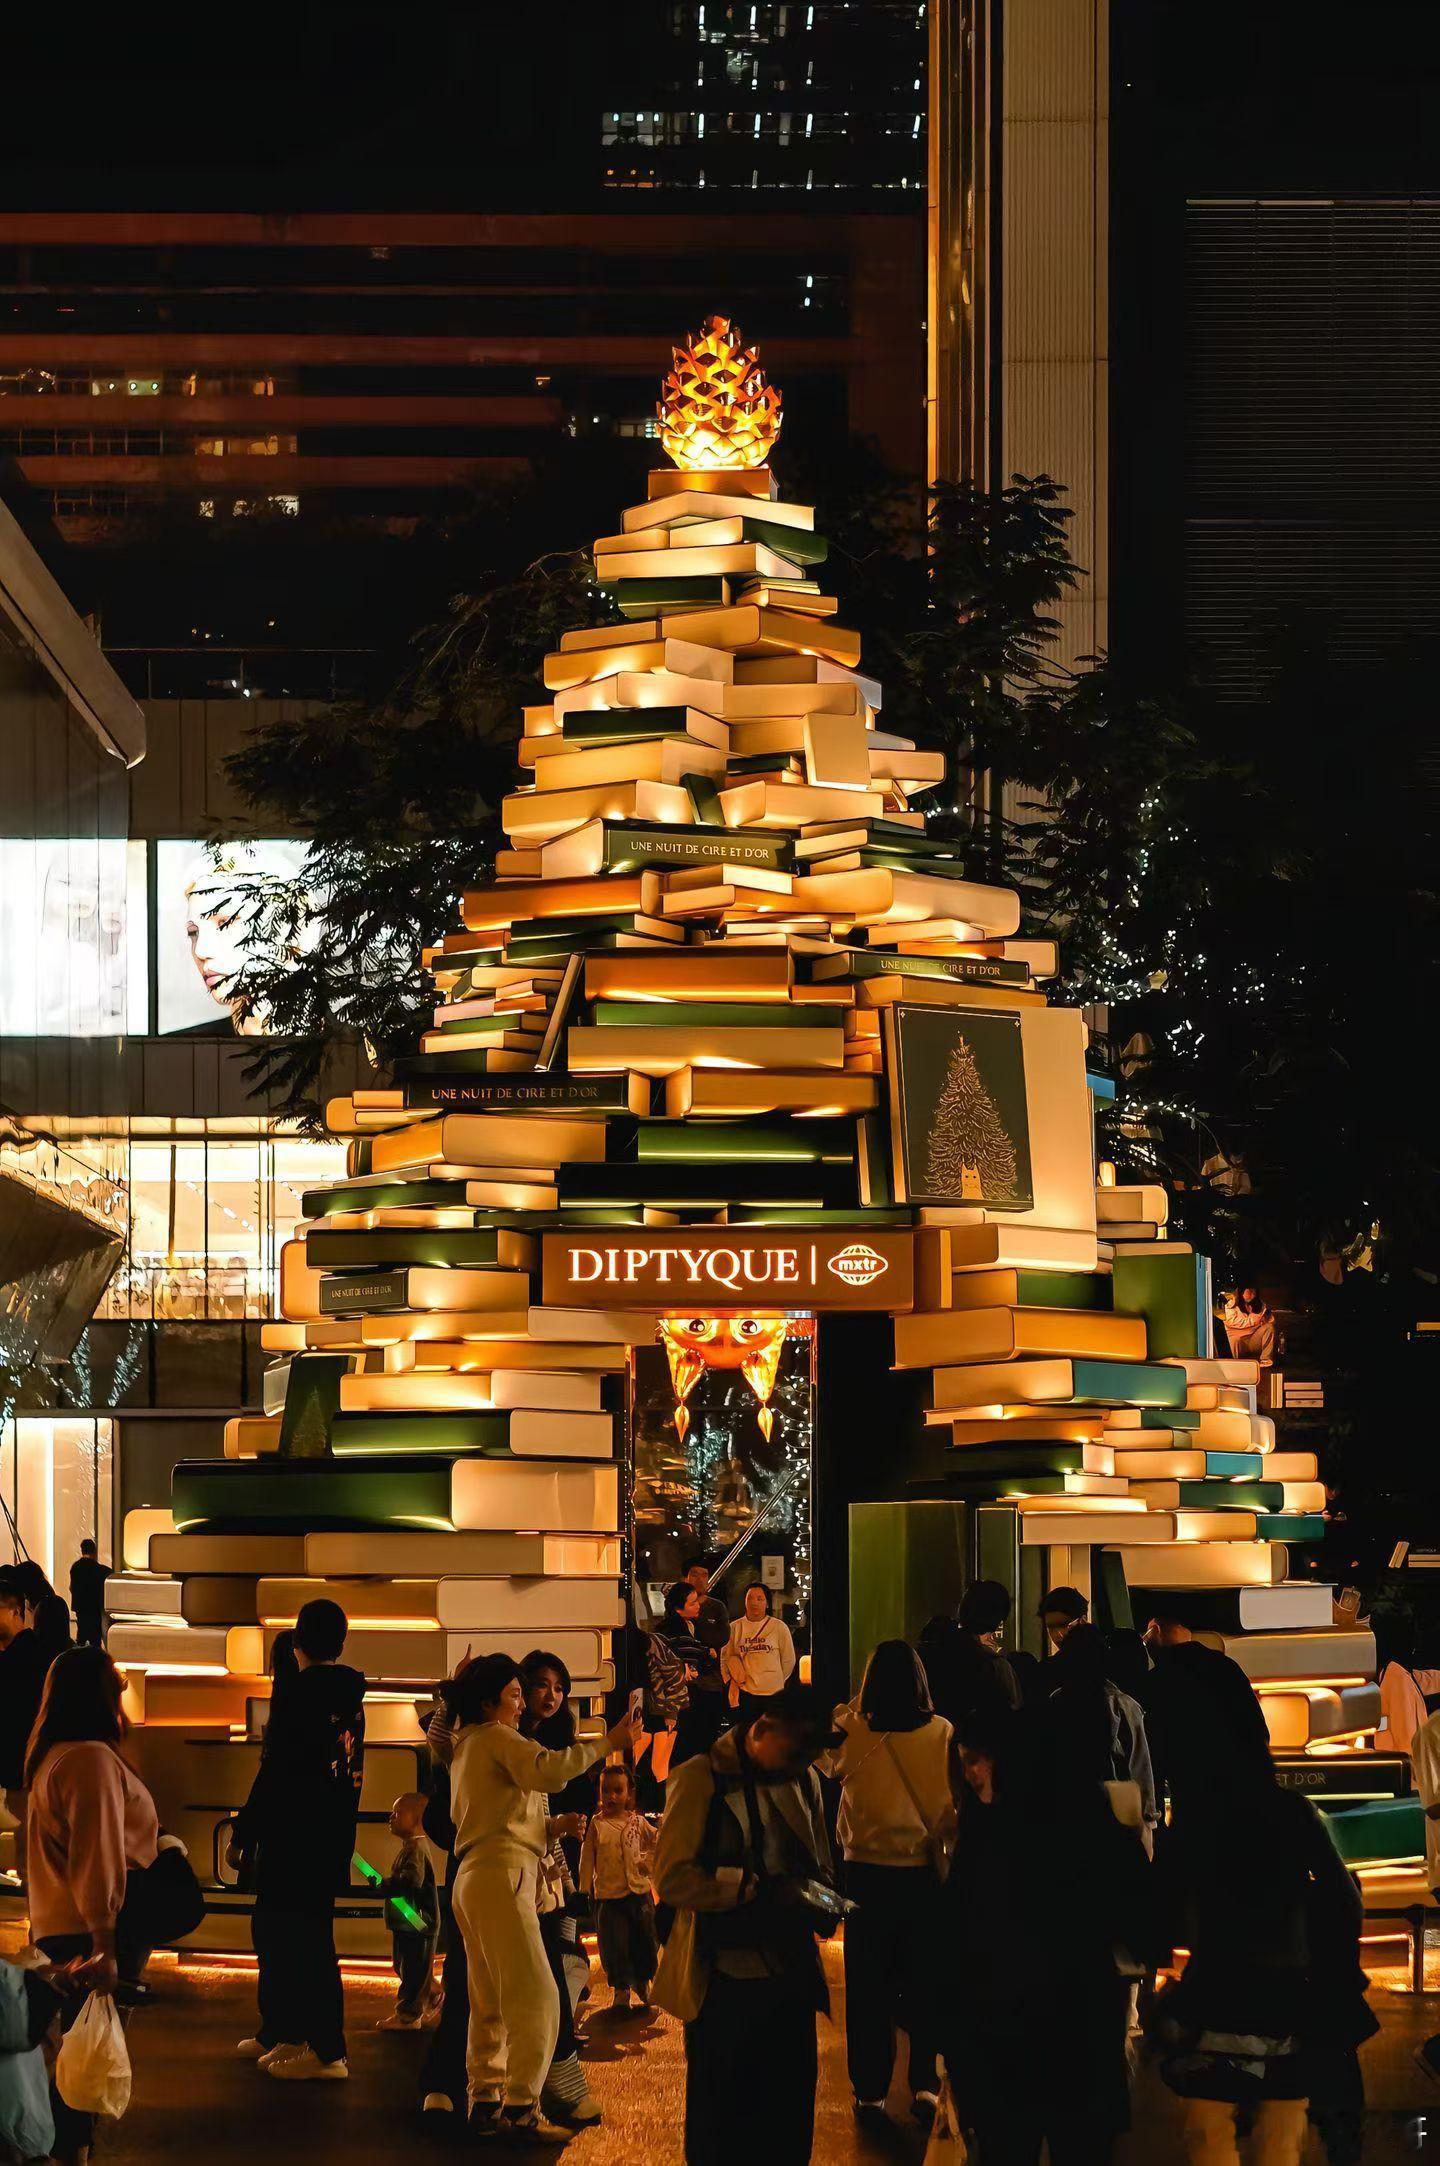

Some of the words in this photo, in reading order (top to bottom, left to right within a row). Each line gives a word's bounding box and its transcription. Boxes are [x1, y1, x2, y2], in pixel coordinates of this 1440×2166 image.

[630, 841, 652, 851] UNE
[655, 842, 682, 853] NUIT
[685, 844, 700, 854] DE
[702, 845, 727, 856] CIRE
[730, 847, 742, 857] ET
[744, 848, 769, 858] D'OR
[880, 960, 900, 970] UNE
[942, 963, 964, 974] CIRE
[966, 965, 977, 975] ET
[979, 966, 1000, 976] D'OR
[431, 1088, 457, 1100] UNE
[461, 1088, 492, 1100] NUIT
[497, 1087, 512, 1099] DE
[516, 1087, 546, 1098] CIRE
[551, 1087, 563, 1098] ET
[569, 1086, 599, 1098] D'OR
[568, 1248, 800, 1291] DIPTYQUE
[838, 1257, 878, 1271] mxtr
